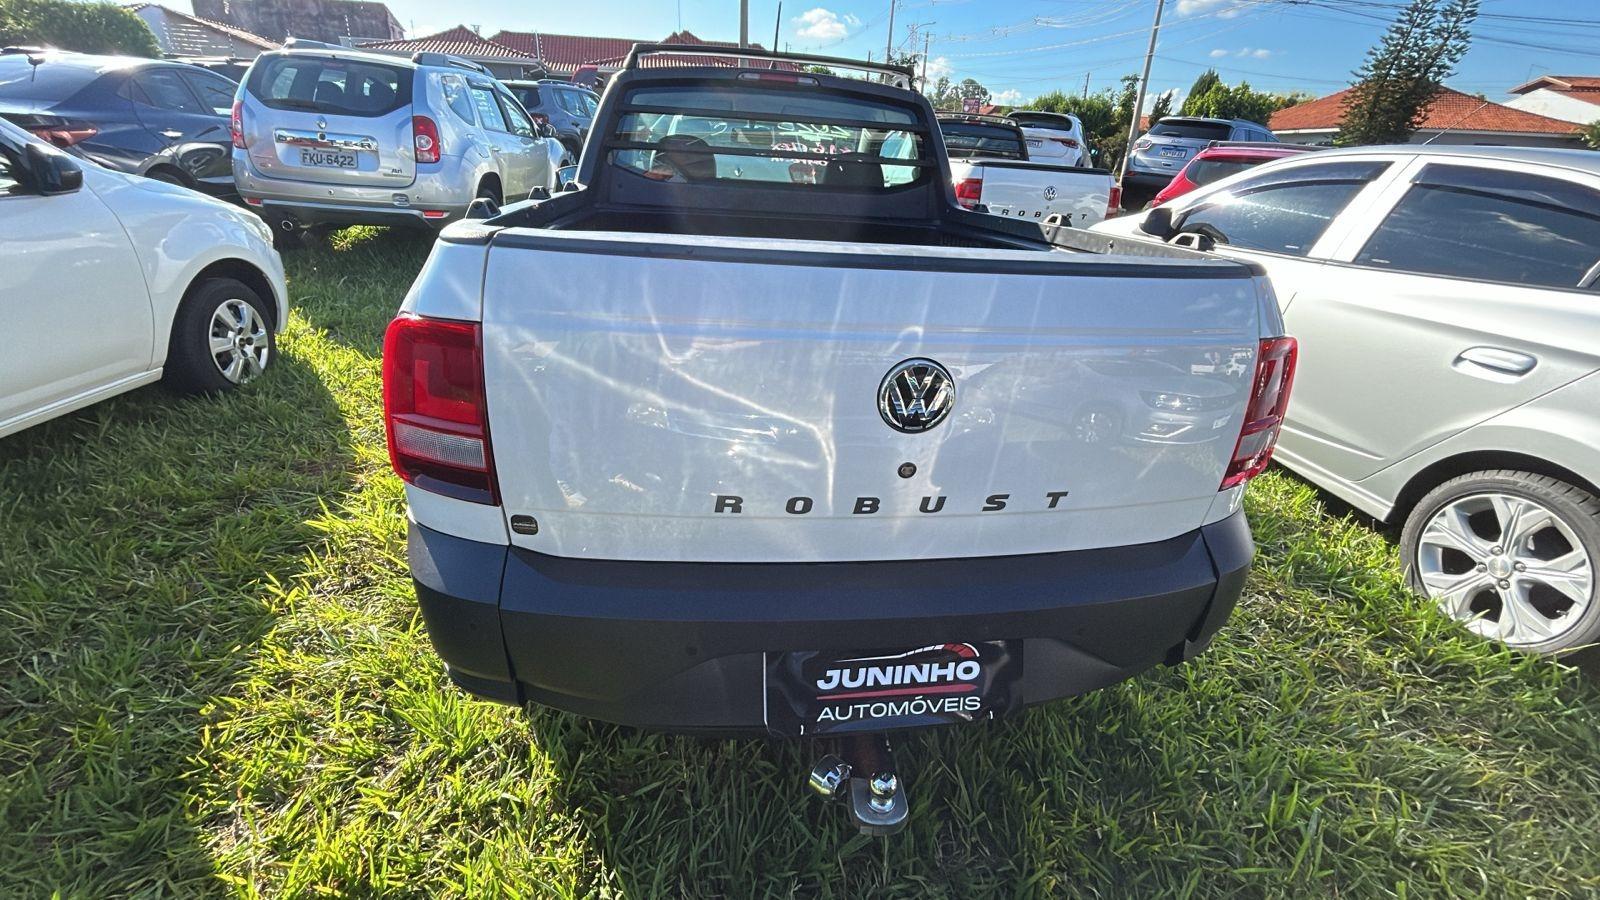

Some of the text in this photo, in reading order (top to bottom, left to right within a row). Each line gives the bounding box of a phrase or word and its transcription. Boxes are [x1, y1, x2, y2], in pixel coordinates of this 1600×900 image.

[1002, 209, 1087, 220] ROBST
[877, 357, 956, 434] VW
[714, 491, 1069, 515] ROBUST
[816, 660, 981, 690] JUNINHO
[816, 696, 981, 722] AUTOMÓVEIS
